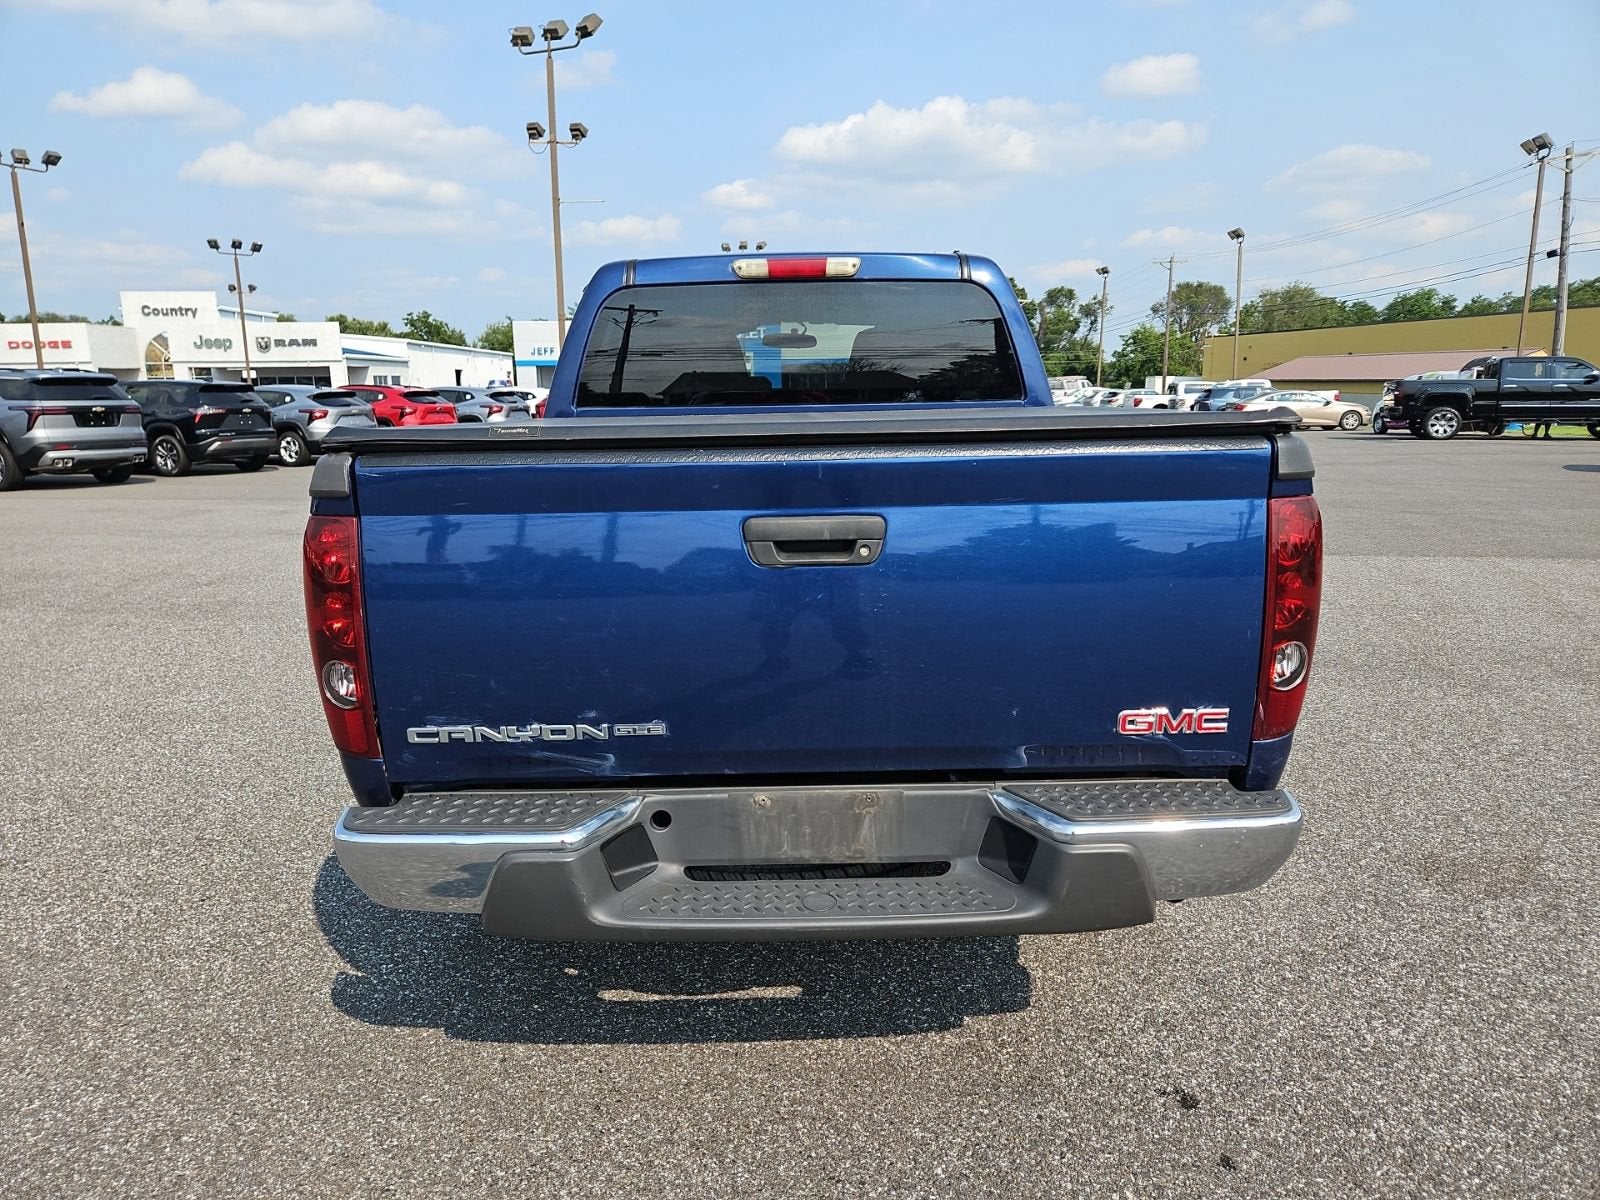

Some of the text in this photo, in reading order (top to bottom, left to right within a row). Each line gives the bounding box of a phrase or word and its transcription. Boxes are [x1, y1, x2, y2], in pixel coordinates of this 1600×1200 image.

[141, 304, 198, 319] Country
[8, 340, 73, 350] DODGE
[193, 335, 233, 352] Jeep
[274, 338, 318, 348] RAM
[530, 346, 556, 356] JEFF
[1117, 706, 1230, 736] GMC
[406, 723, 609, 744] CANYON
